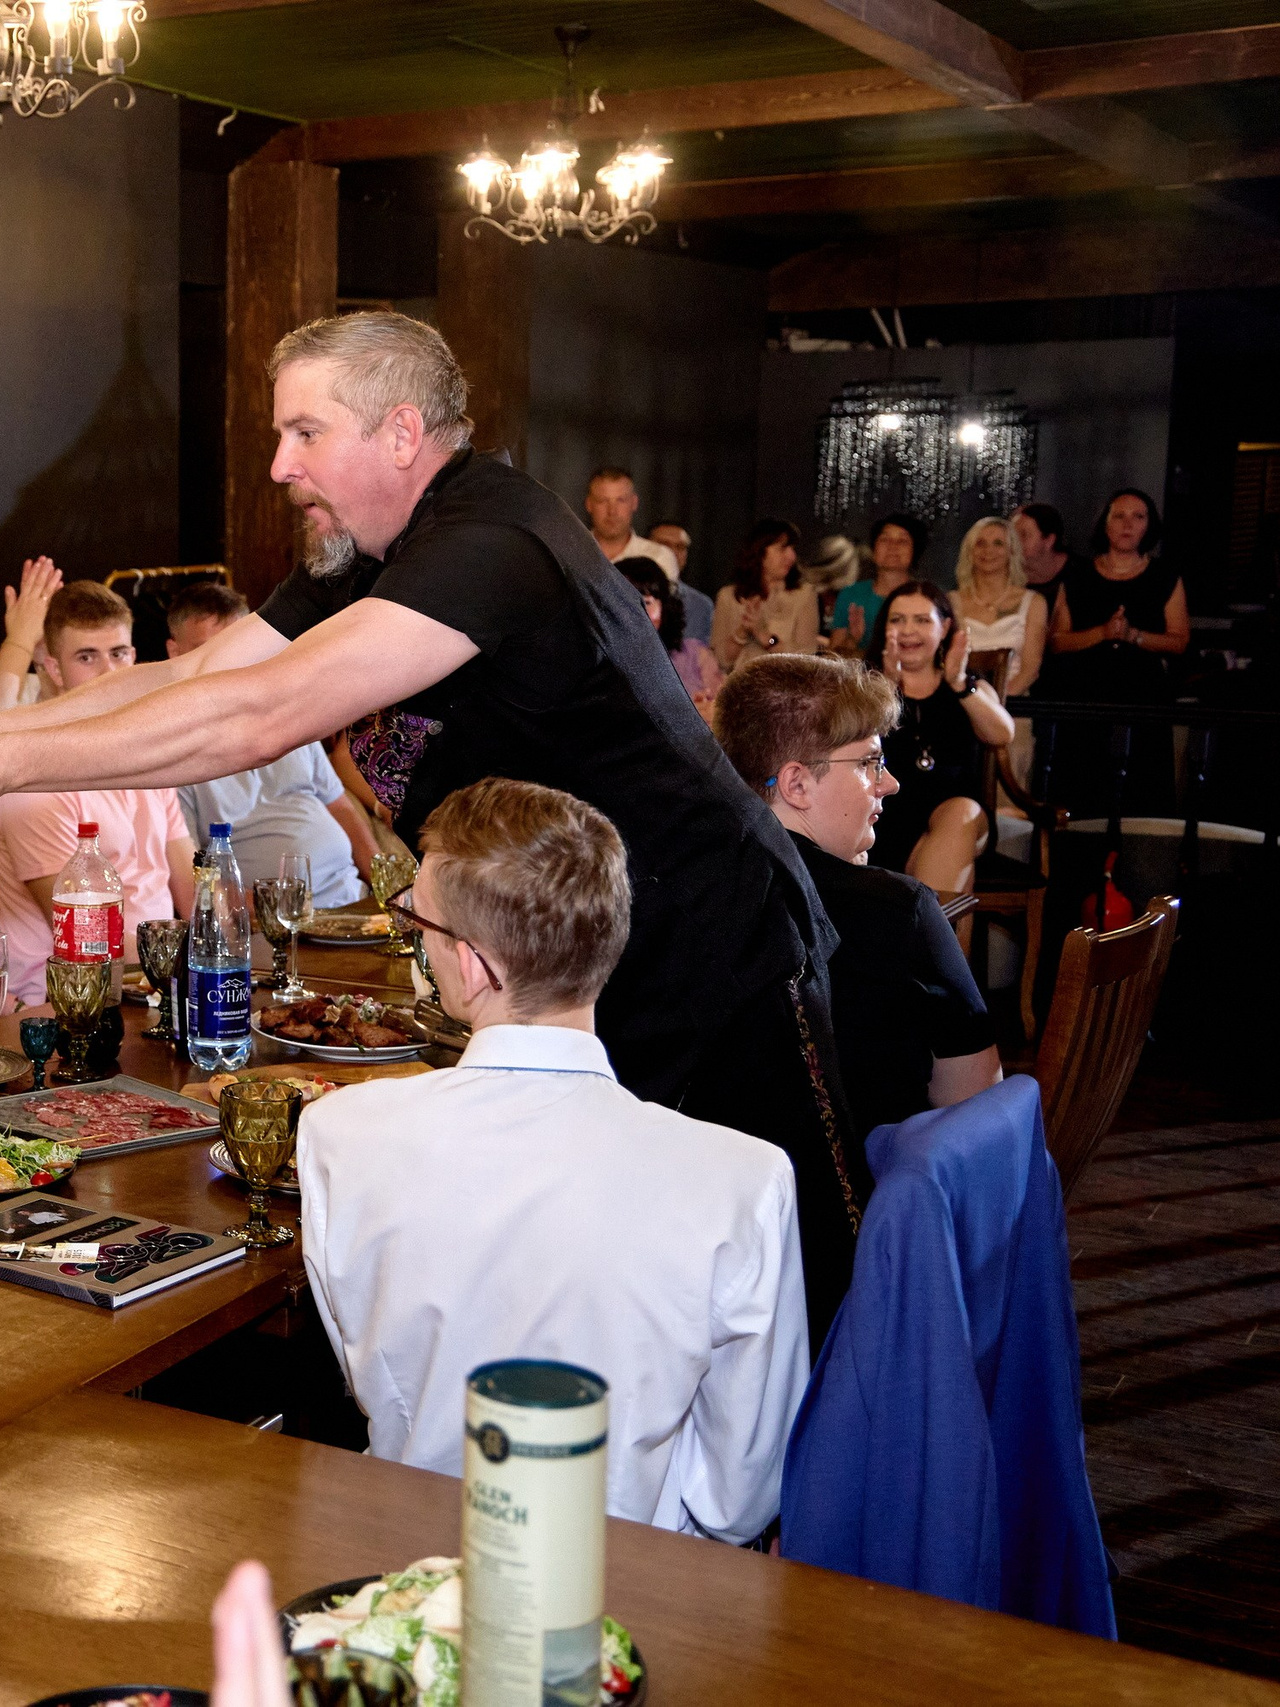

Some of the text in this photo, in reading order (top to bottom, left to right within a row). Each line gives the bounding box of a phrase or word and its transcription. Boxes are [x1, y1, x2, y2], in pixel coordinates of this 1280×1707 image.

[54, 935, 69, 950] Cola
[64, 1218, 130, 1244] СКНОЙ
[474, 1480, 511, 1503] GLEN
